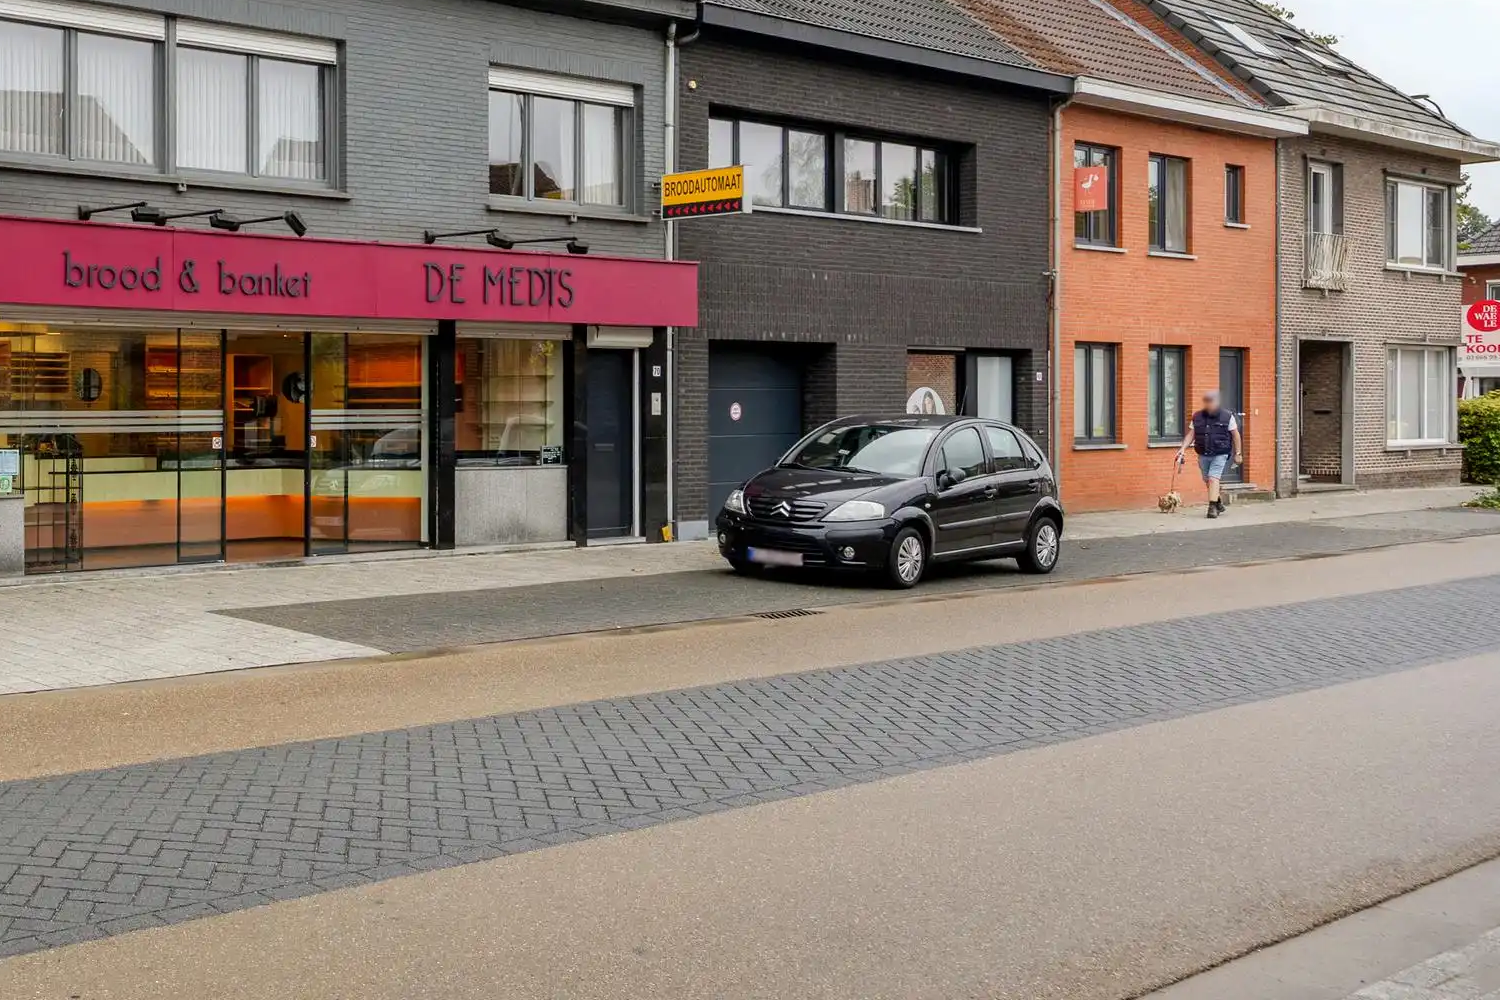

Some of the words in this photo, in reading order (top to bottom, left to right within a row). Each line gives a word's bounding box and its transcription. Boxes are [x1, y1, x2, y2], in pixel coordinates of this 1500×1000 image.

[664, 174, 741, 197] BROODAUTOMAAT
[63, 250, 162, 291] brood
[179, 259, 199, 293] &
[217, 260, 312, 298] banket
[423, 262, 465, 304] DE
[1482, 305, 1497, 313] DE
[1483, 320, 1497, 328] LE
[1466, 335, 1483, 343] TE
[1466, 344, 1500, 353] KOO
